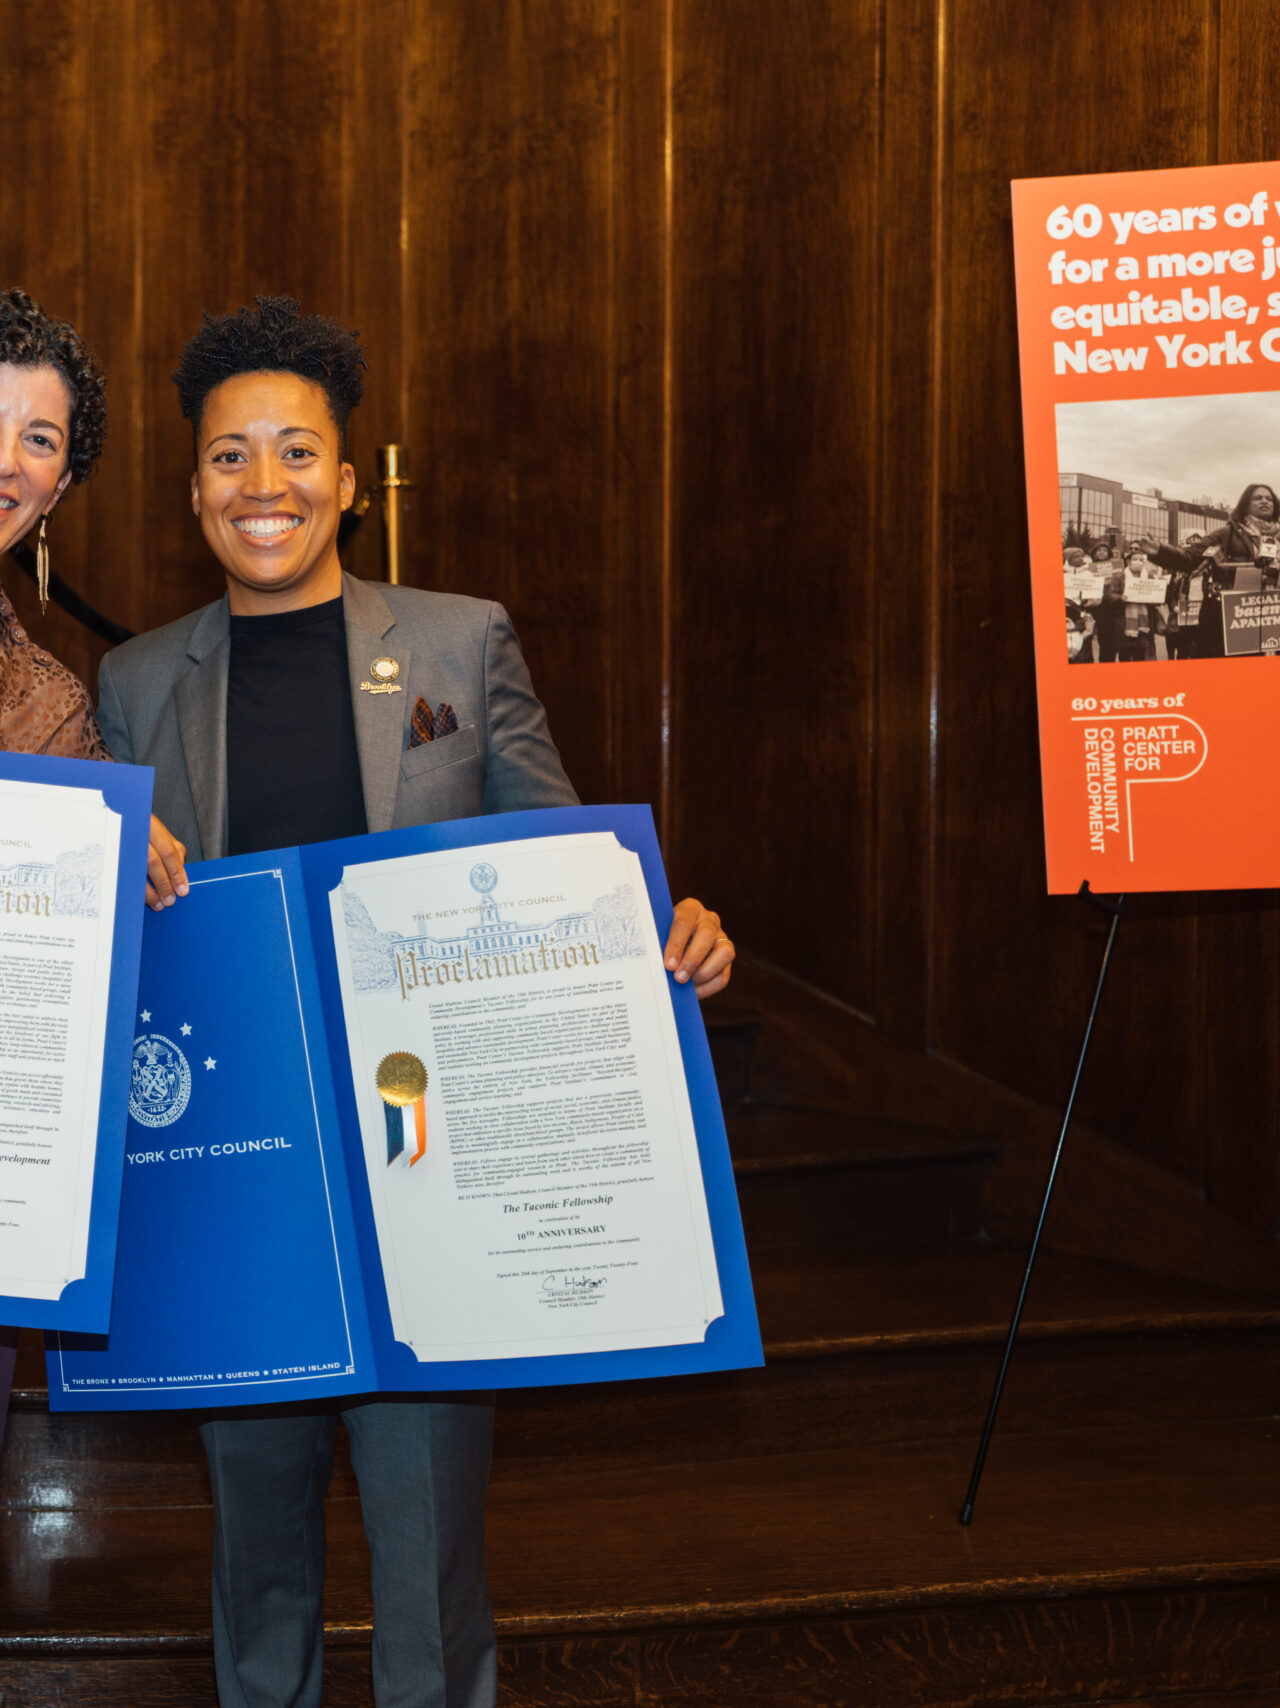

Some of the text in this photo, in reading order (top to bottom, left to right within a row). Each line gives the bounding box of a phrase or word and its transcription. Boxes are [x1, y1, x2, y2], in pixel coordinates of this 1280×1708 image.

[1046, 203, 1103, 239] 60
[1109, 205, 1217, 245] years
[1224, 191, 1268, 227] of
[1048, 250, 1108, 284] for
[1115, 257, 1139, 281] a
[1147, 248, 1255, 279] more
[1051, 285, 1260, 337] equitable,
[1053, 340, 1149, 375] New
[1155, 330, 1253, 368] York
[1071, 692, 1185, 713] 60 years of
[1122, 725, 1179, 740] PRATT
[1123, 740, 1195, 756] CENTER
[1124, 756, 1160, 771] FOR
[1084, 728, 1104, 853] DEVELOPMENT
[1100, 727, 1119, 832] COMMUNITY
[412, 913, 432, 921] THE
[435, 909, 459, 918] NEW
[462, 905, 490, 914] YORK
[518, 895, 567, 907] COUNCIL
[396, 937, 600, 1001] Proclamation
[127, 1136, 291, 1164] YORK CITY COUNCIL
[503, 1194, 613, 1213] The Taconic Fellowship
[537, 1224, 607, 1239] ANNIVERSARY
[166, 1374, 214, 1382] MANHATTAN
[225, 1370, 260, 1379] QUEENS
[272, 1366, 306, 1375] STATEN
[308, 1362, 341, 1371] ISLAND
